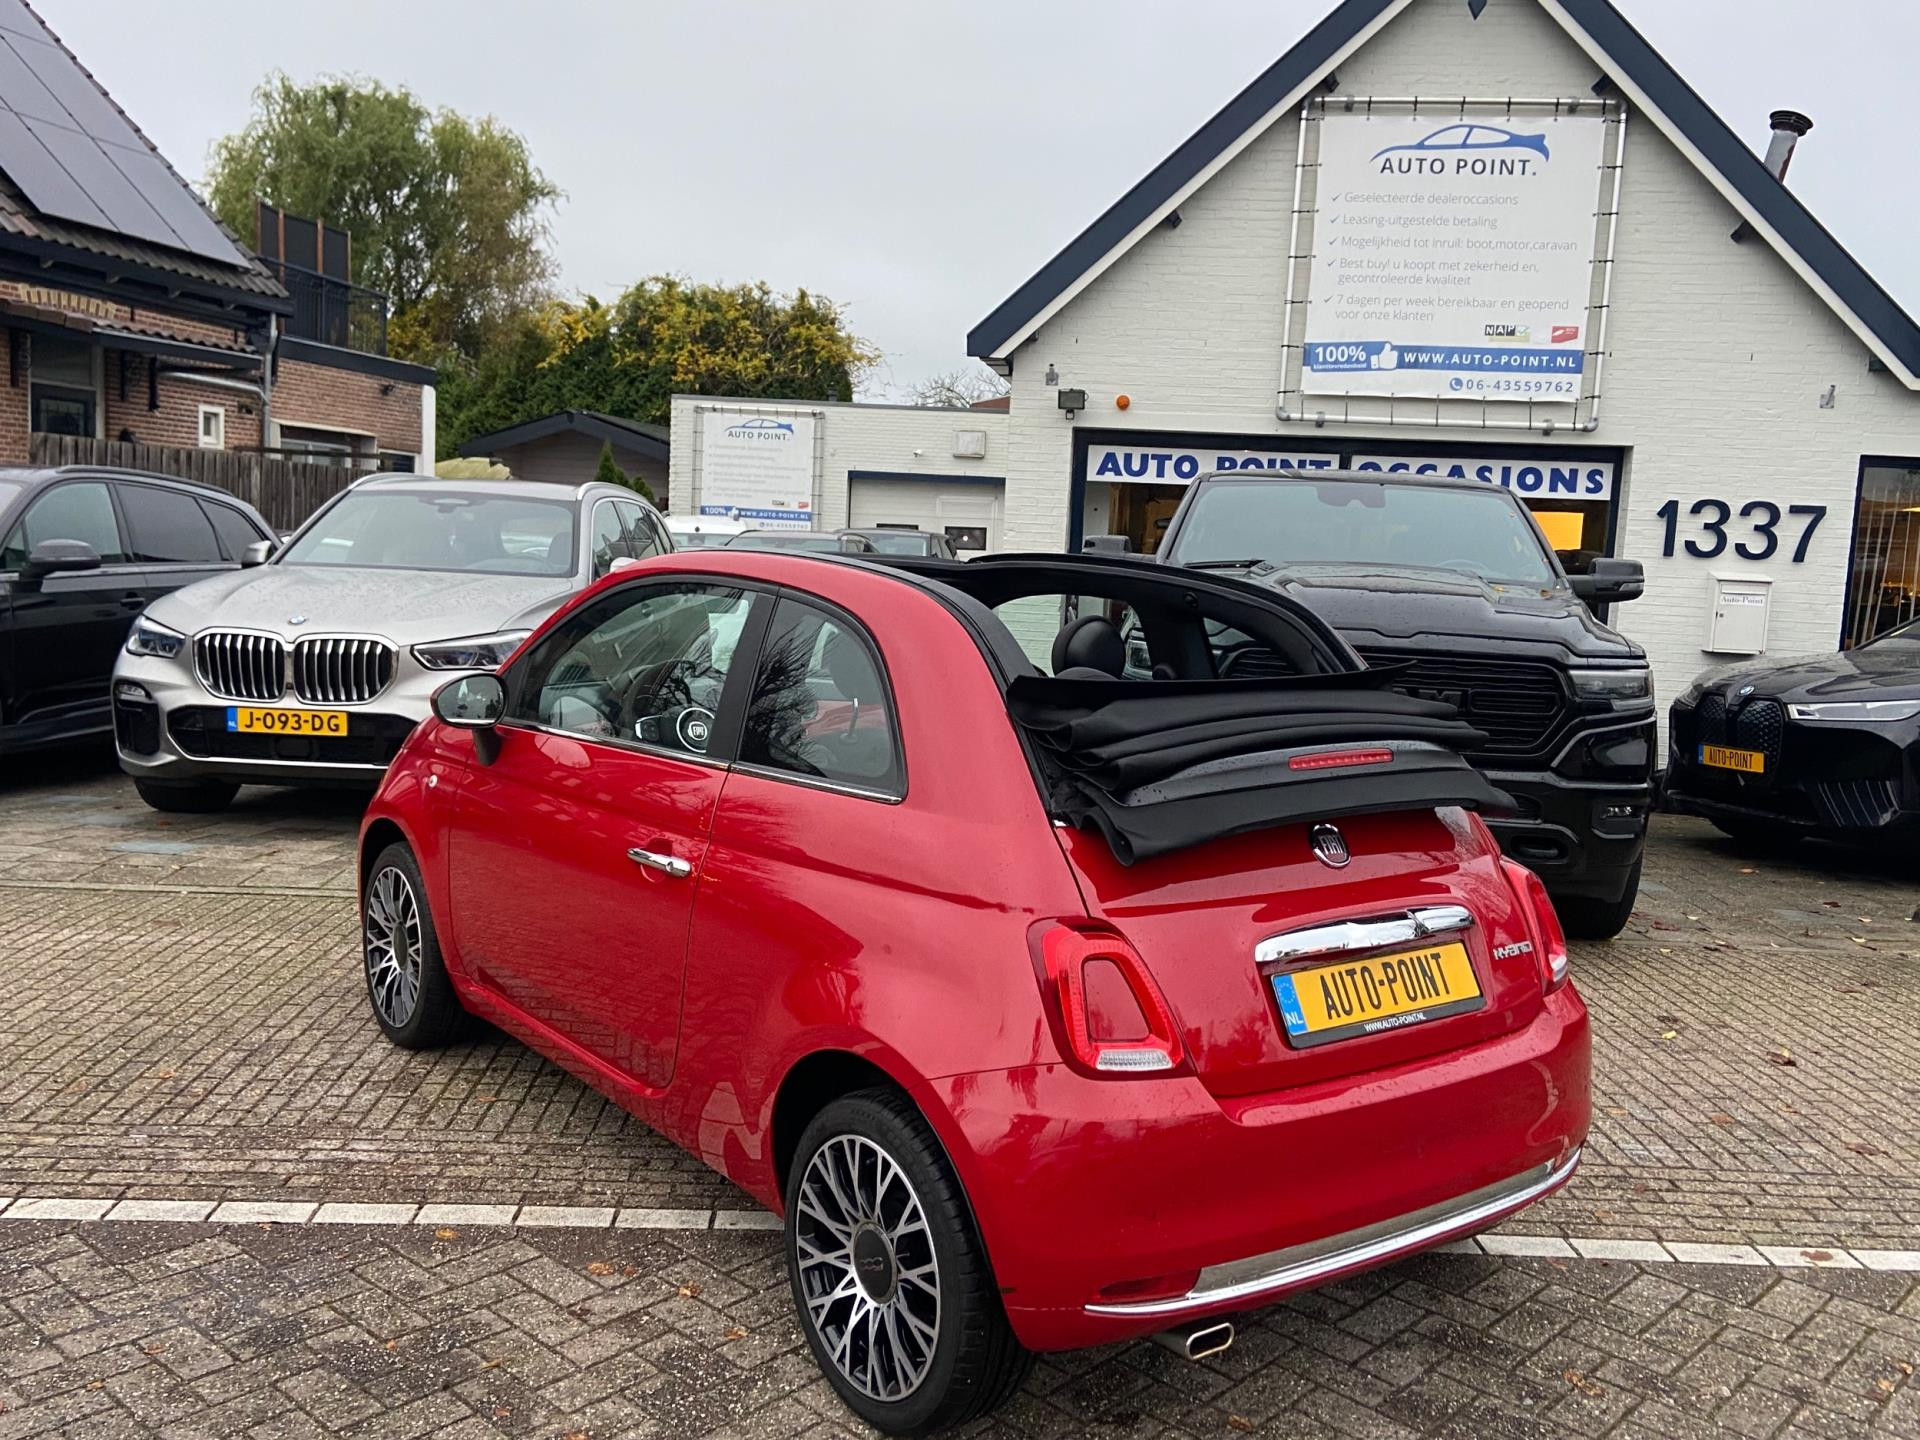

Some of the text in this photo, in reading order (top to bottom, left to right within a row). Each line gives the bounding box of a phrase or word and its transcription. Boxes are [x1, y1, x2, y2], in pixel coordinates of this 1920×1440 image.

[1380, 157, 1446, 175] AUTO
[1344, 192, 1519, 206] Geselecteerde dealeroccasions
[1343, 213, 1498, 230] Leasing-uitgestelde betaling
[1341, 236, 1411, 250] Mogelijkheid
[1414, 238, 1429, 249] tot
[1432, 237, 1463, 249] inruil:
[1340, 258, 1363, 269] Best
[1393, 260, 1401, 270] u
[1403, 259, 1435, 272] koopt
[1438, 261, 1461, 271] met
[1463, 260, 1519, 272] zekerheid
[1338, 272, 1471, 286] gecontroleerde kwaliteit
[1337, 293, 1569, 312] 7 dagen per week bereikbaar en geopend
[1335, 309, 1434, 321] voor onze klanten
[1485, 325, 1516, 336] NAP
[1315, 345, 1367, 362] 100%
[1403, 351, 1576, 368] WWW.AUTO-POINT.NL
[1465, 379, 1574, 393] 06-43559762
[728, 430, 754, 440] AUTO
[1096, 451, 1199, 479] AUTO
[705, 506, 727, 515] 100%
[1656, 499, 1828, 563] 1337
[244, 711, 340, 733] J-093-DG
[1708, 747, 1753, 769] AUTO-POINT
[1286, 952, 1451, 1026] NL AUTO-POINT
[1363, 1011, 1427, 1033] WWW.AUTO-POINT.NL
